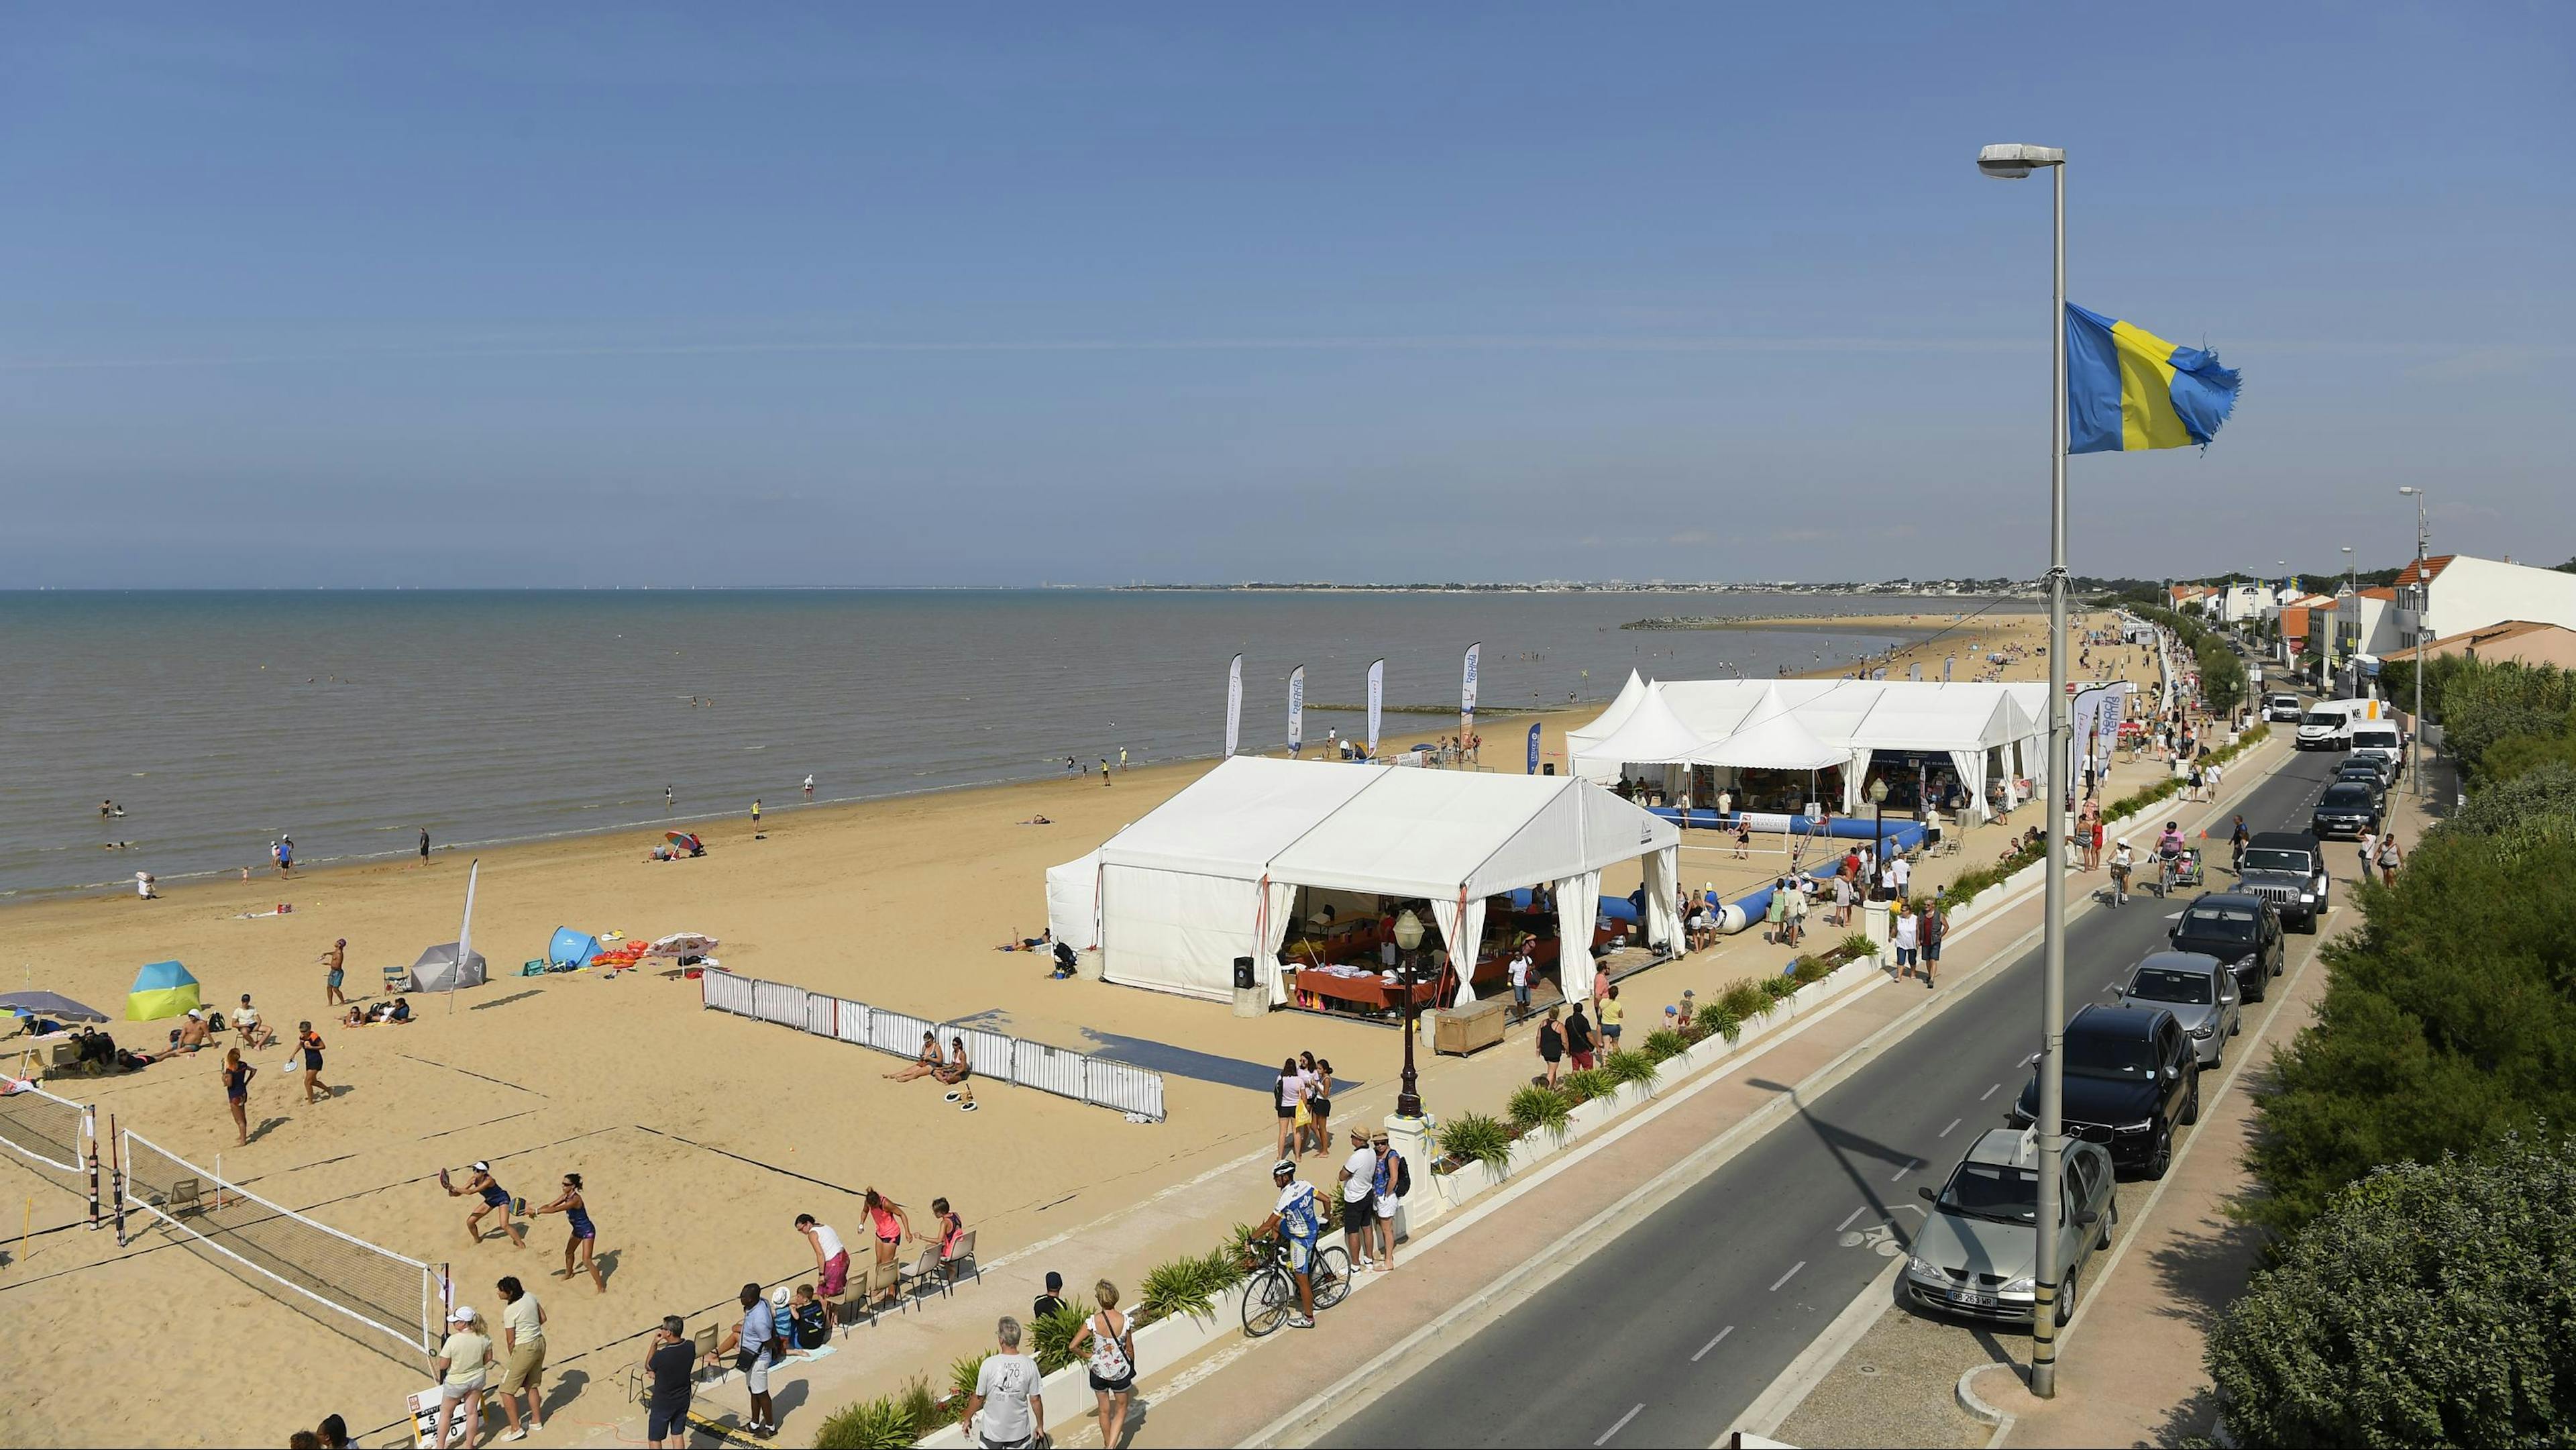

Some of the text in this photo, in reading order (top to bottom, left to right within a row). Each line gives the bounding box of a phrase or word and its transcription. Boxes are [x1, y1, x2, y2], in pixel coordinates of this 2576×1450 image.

[2099, 696, 2114, 735] beach
[2108, 696, 2120, 732] tennis
[1010, 1369, 1019, 1378] 70
[429, 1414, 435, 1425] 5
[451, 1427, 458, 1436] 0
